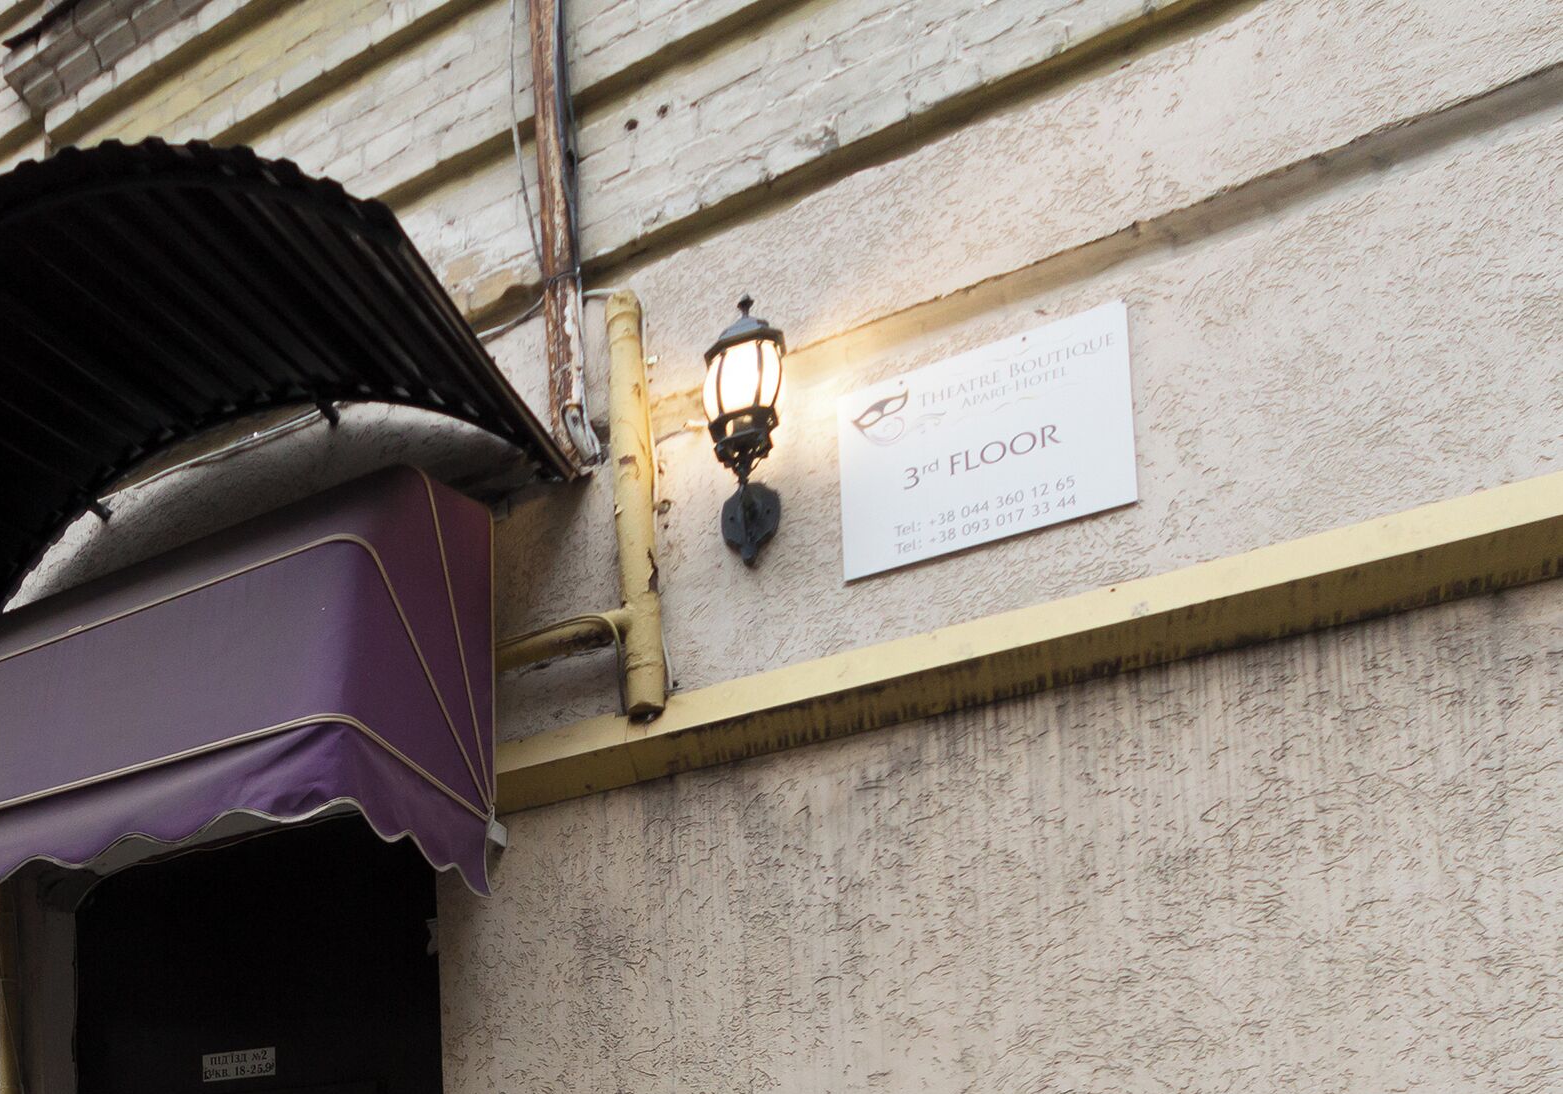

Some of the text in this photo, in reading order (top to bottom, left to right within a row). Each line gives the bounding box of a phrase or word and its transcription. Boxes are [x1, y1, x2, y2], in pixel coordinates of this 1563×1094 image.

[918, 333, 1115, 408] THEATRE BOUTIQUE
[962, 366, 1069, 409] APART-HOTEL
[903, 424, 1062, 491] 3rd FLOOR
[894, 475, 1076, 538] Tel: +38 044 360 12 65
[894, 493, 1077, 556] Tel: +38 093 017 33 44
